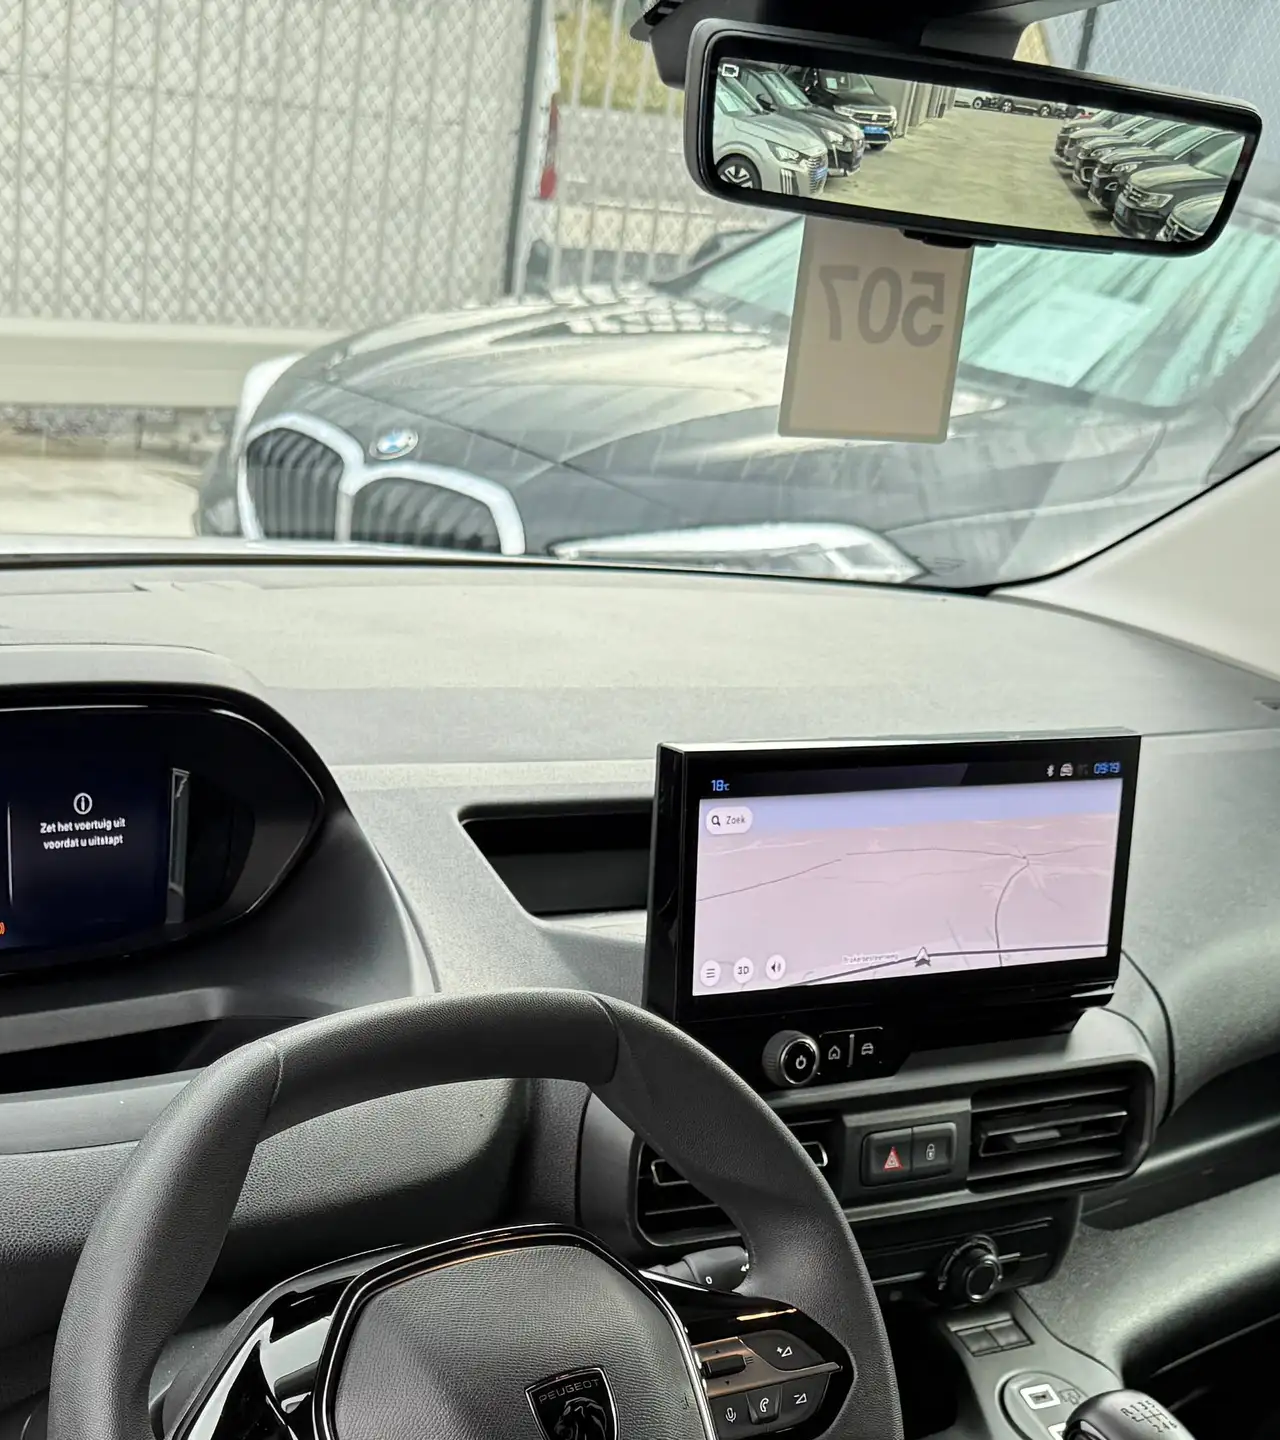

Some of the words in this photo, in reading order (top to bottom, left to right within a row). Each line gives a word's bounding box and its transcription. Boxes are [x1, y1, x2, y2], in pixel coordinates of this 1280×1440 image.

[40, 822, 56, 834] Zet
[57, 821, 73, 832] het
[74, 818, 112, 831] voertuig
[113, 817, 126, 828] uit
[726, 815, 745, 825] Zoek
[43, 837, 79, 850] voordat
[80, 838, 87, 847] u
[88, 834, 123, 847] uitstapt
[737, 966, 749, 975] 3D
[538, 1379, 599, 1404] PEUGEOT
